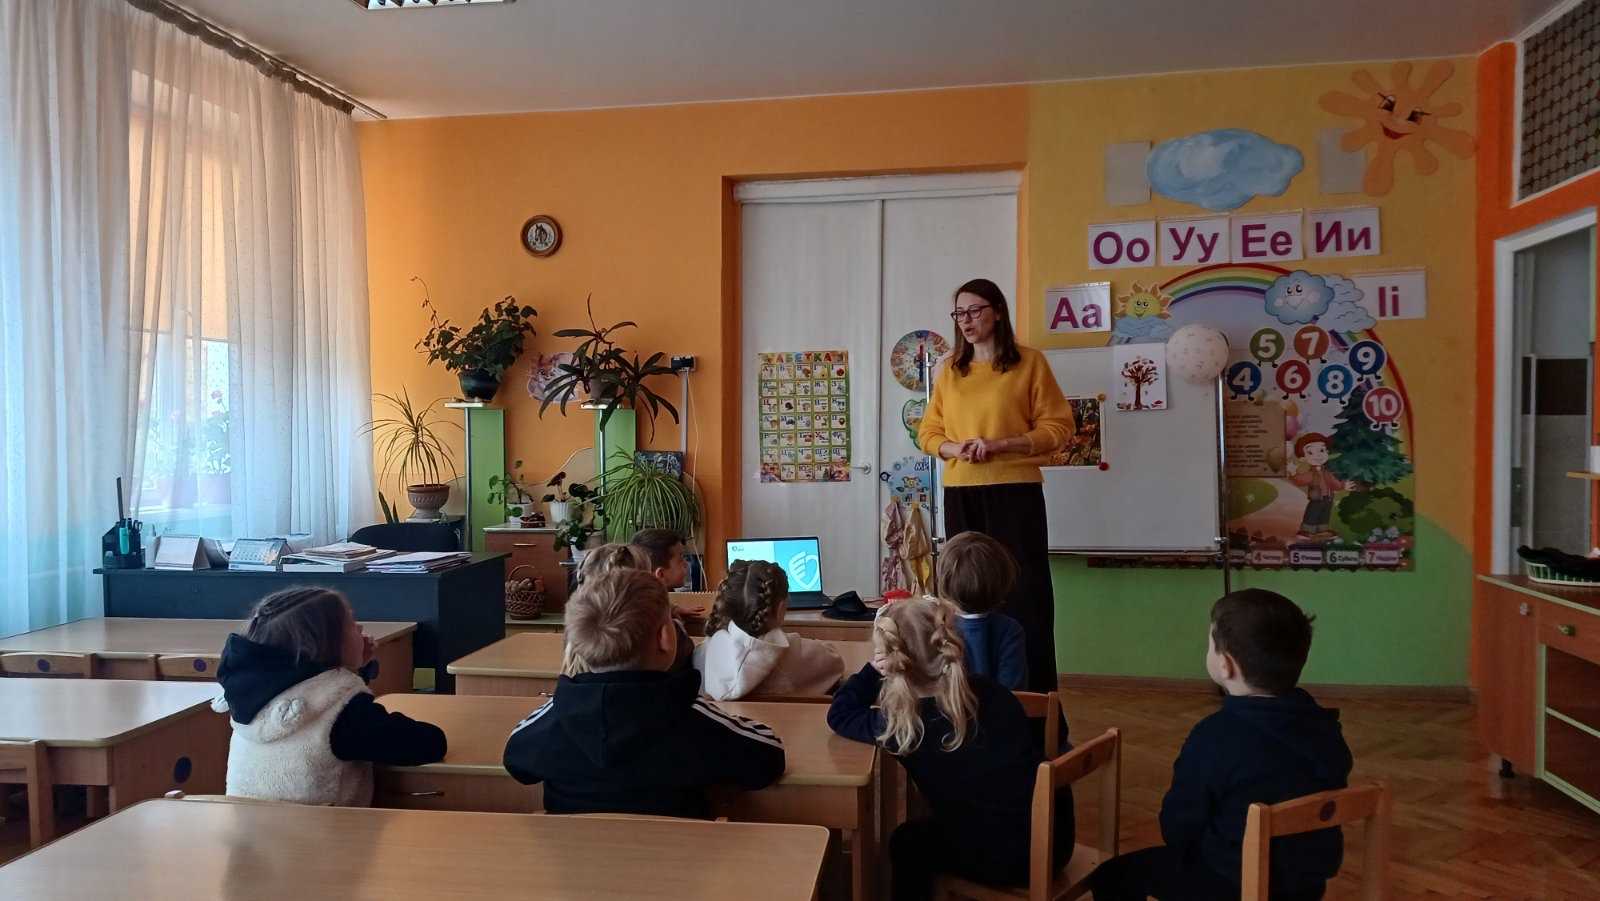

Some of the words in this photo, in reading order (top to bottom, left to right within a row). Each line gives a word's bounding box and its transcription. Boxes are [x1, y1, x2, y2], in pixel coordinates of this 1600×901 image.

[1093, 231, 1150, 265] Оо
[1169, 226, 1220, 263] Уу
[1241, 223, 1293, 258] Ее
[1315, 220, 1371, 253] Ии
[1050, 296, 1102, 330] Аа
[1258, 333, 1276, 358] 5
[1302, 332, 1320, 356] 7
[1356, 346, 1376, 370] 9
[1232, 367, 1254, 389] 4
[1284, 365, 1303, 389] 6
[1325, 370, 1345, 394] 8
[1370, 394, 1398, 416] 10
[1293, 552, 1300, 562] 5
[1330, 552, 1337, 563] 6
[1368, 552, 1376, 563] 7
